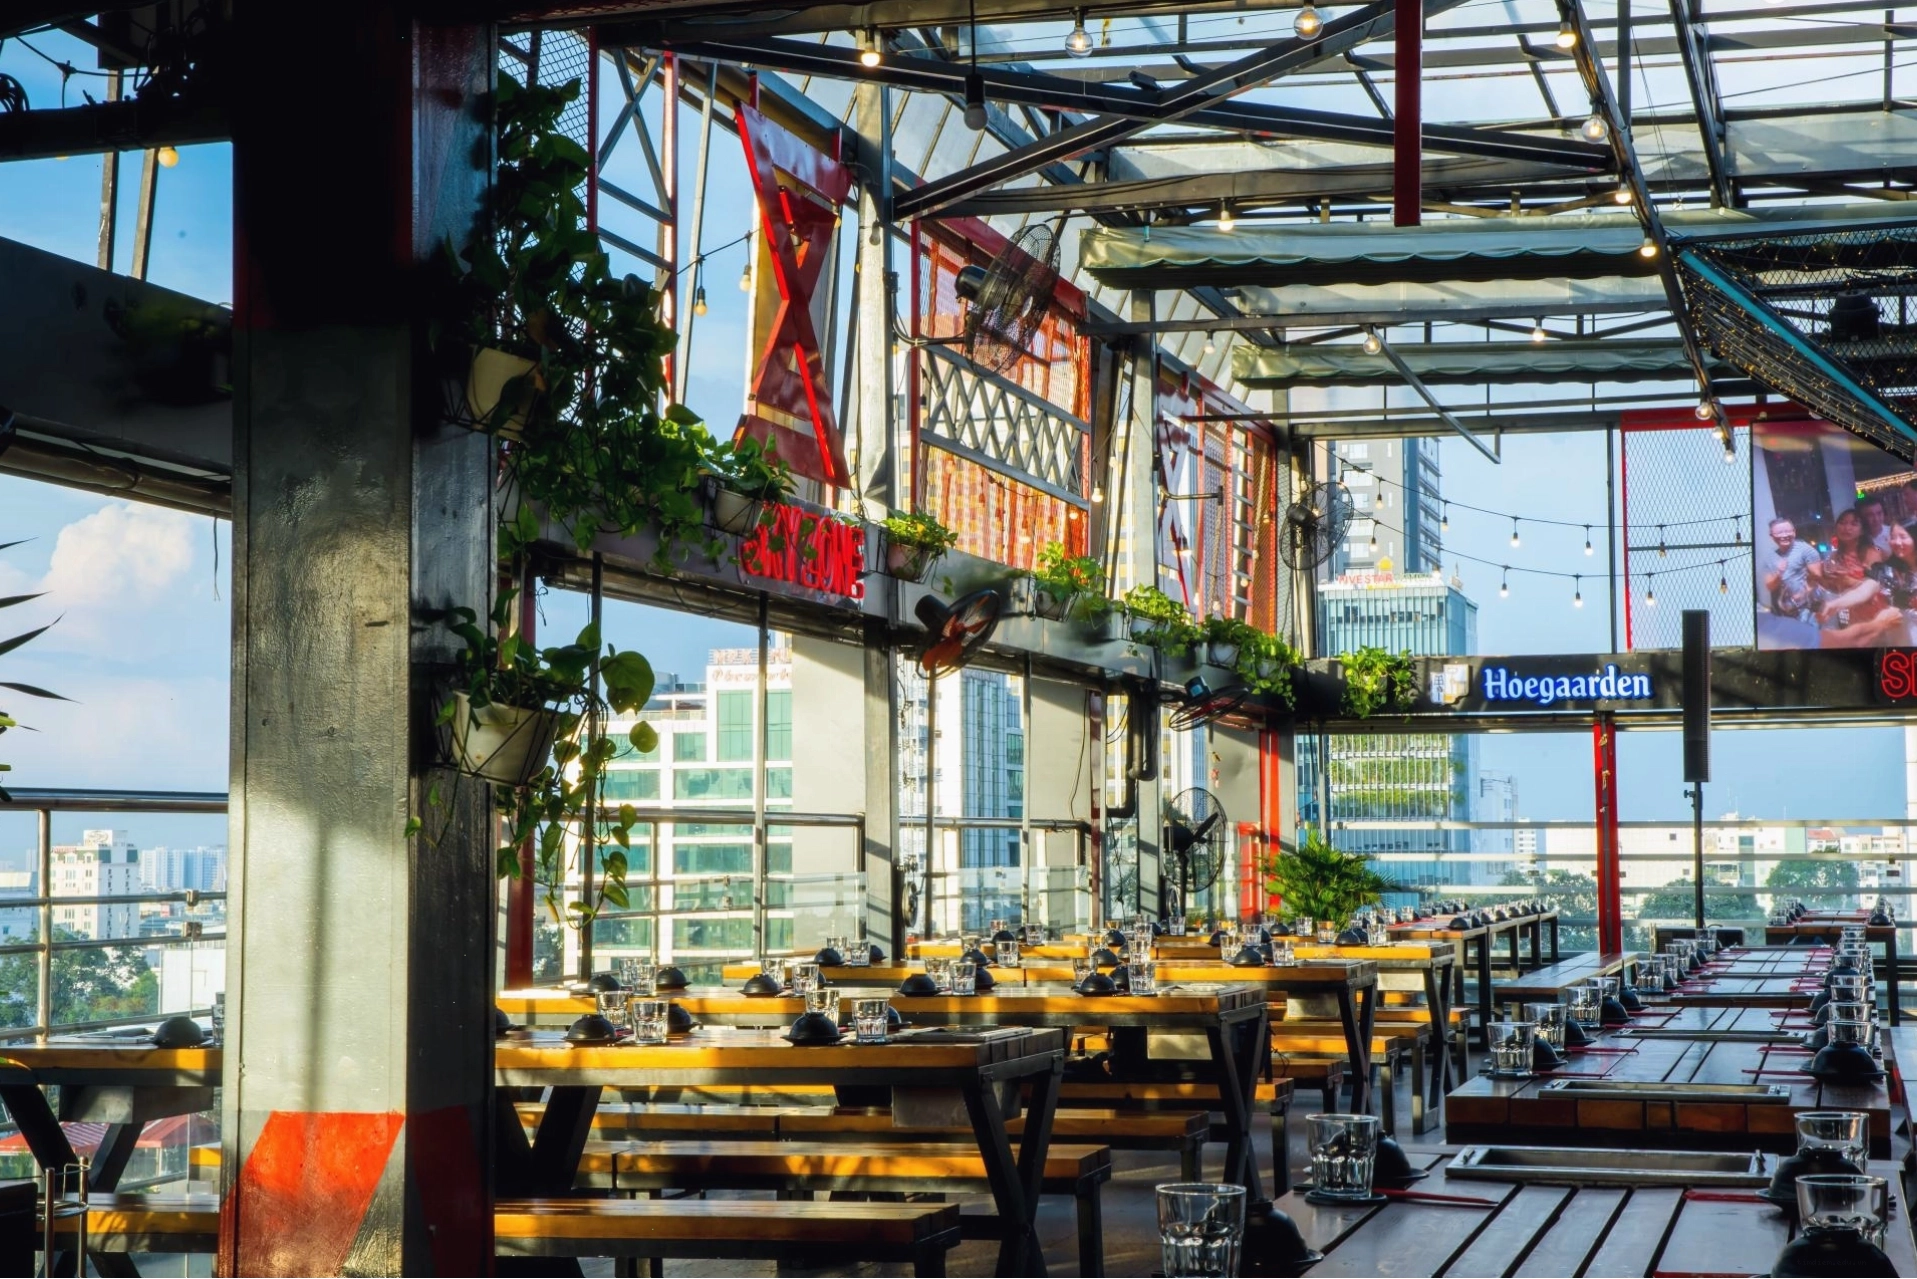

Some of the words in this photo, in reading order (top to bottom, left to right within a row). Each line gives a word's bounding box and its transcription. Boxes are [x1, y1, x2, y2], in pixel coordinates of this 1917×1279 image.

[802, 513, 865, 598] ZONE
[1484, 664, 1652, 704] Hoegaarden
[1881, 651, 1917, 699] S
